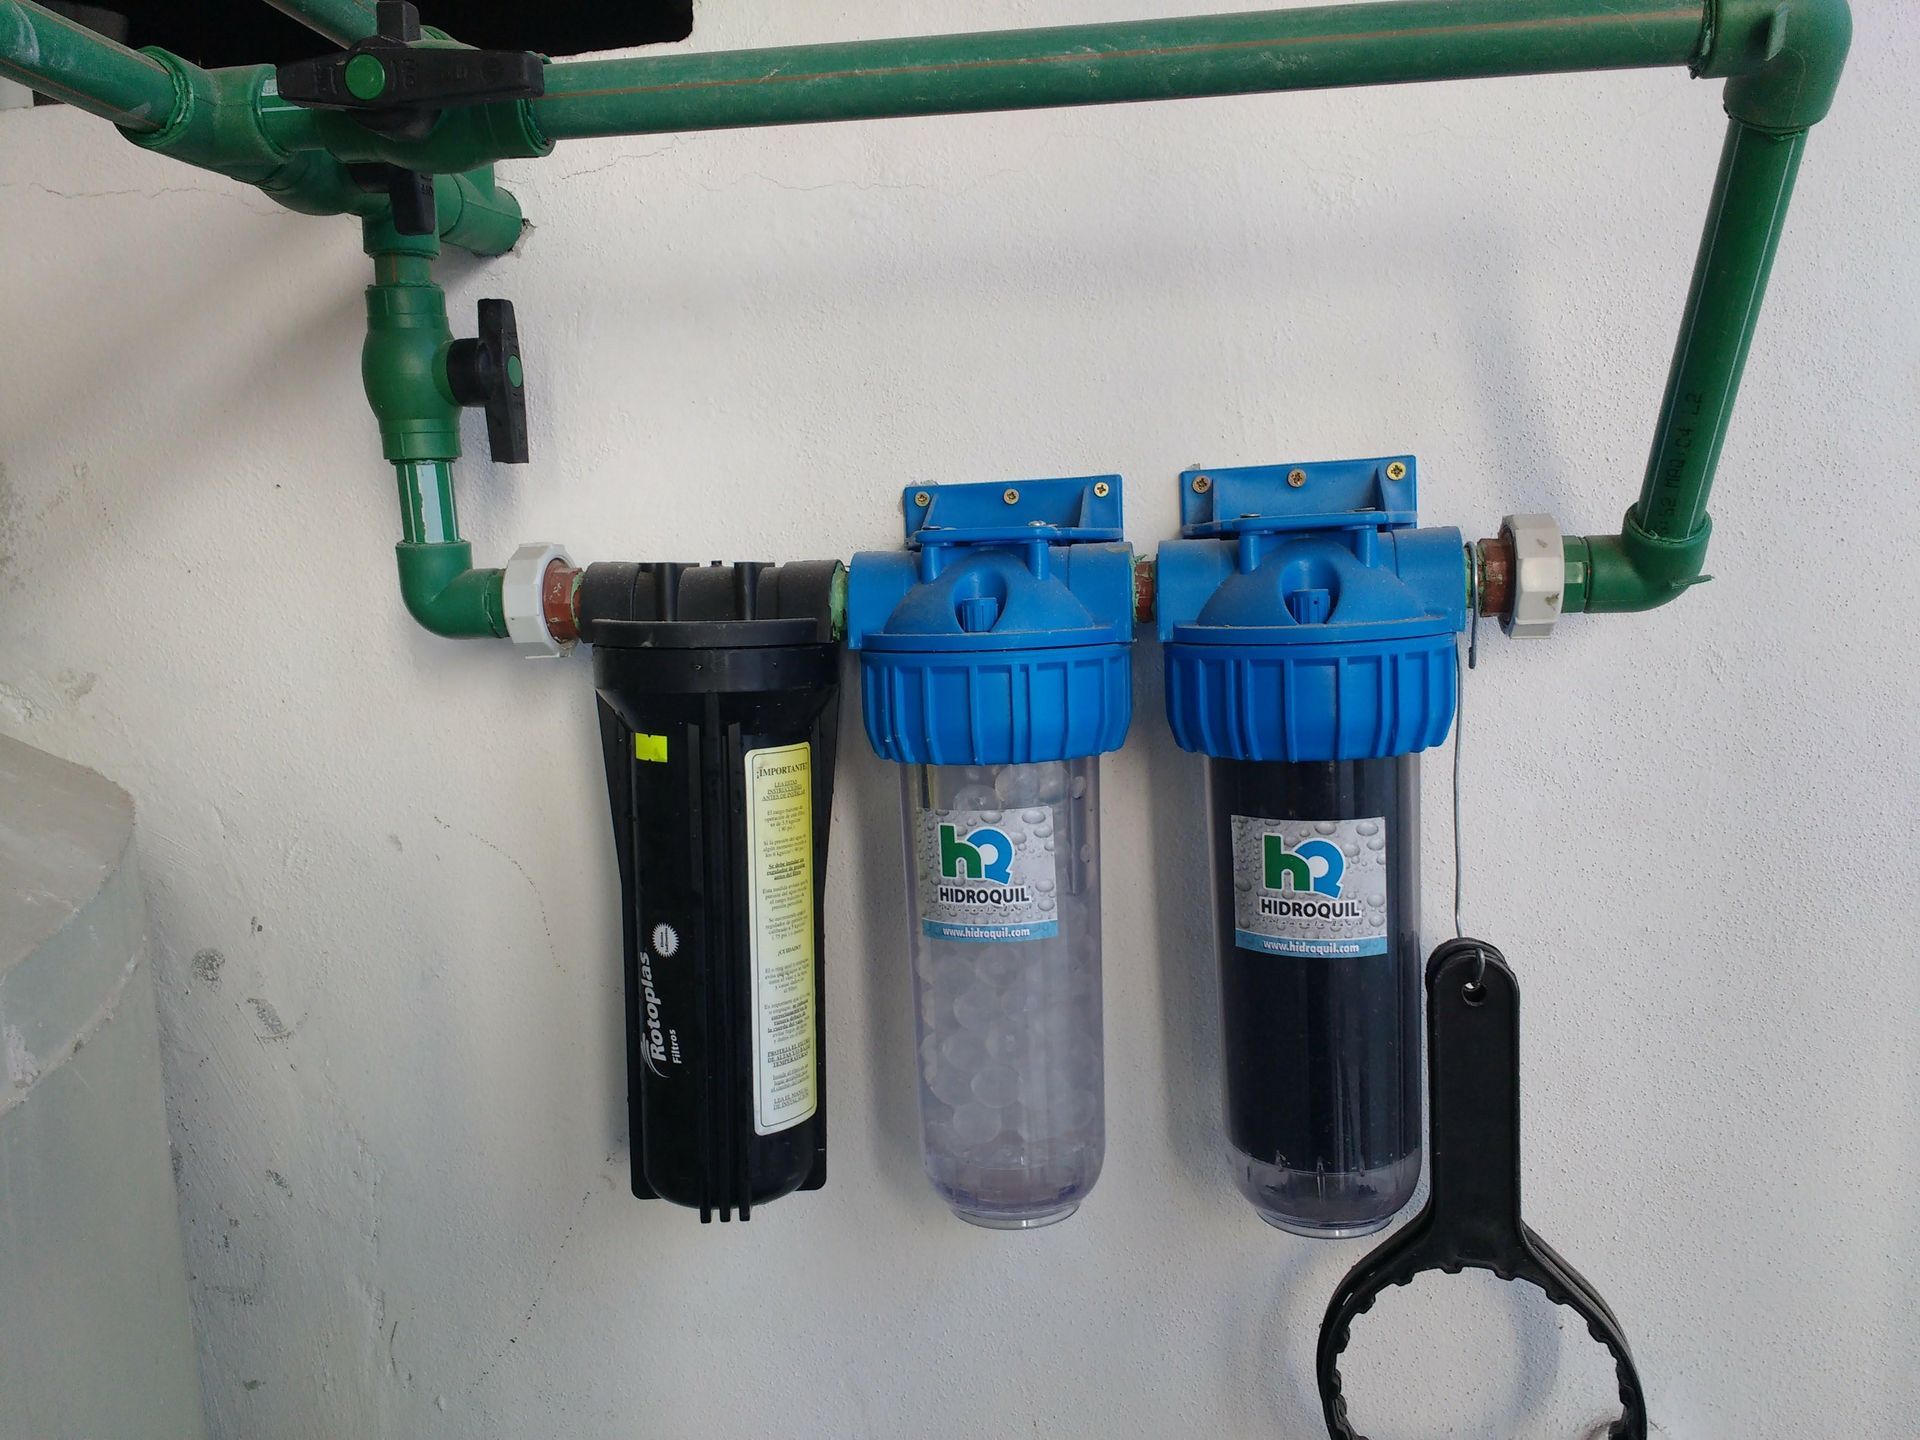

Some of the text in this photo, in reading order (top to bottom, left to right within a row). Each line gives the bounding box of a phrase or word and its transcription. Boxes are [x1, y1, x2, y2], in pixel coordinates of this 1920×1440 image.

[939, 887, 1030, 906] HIDROQUIL
[1260, 899, 1360, 919] HIDROQUIL
[942, 926, 1031, 941] www.hidroquil.com
[1262, 939, 1360, 955] www.hidroquil.com
[640, 951, 668, 1062] Rotoplas
[668, 1028, 682, 1065] Filtros
